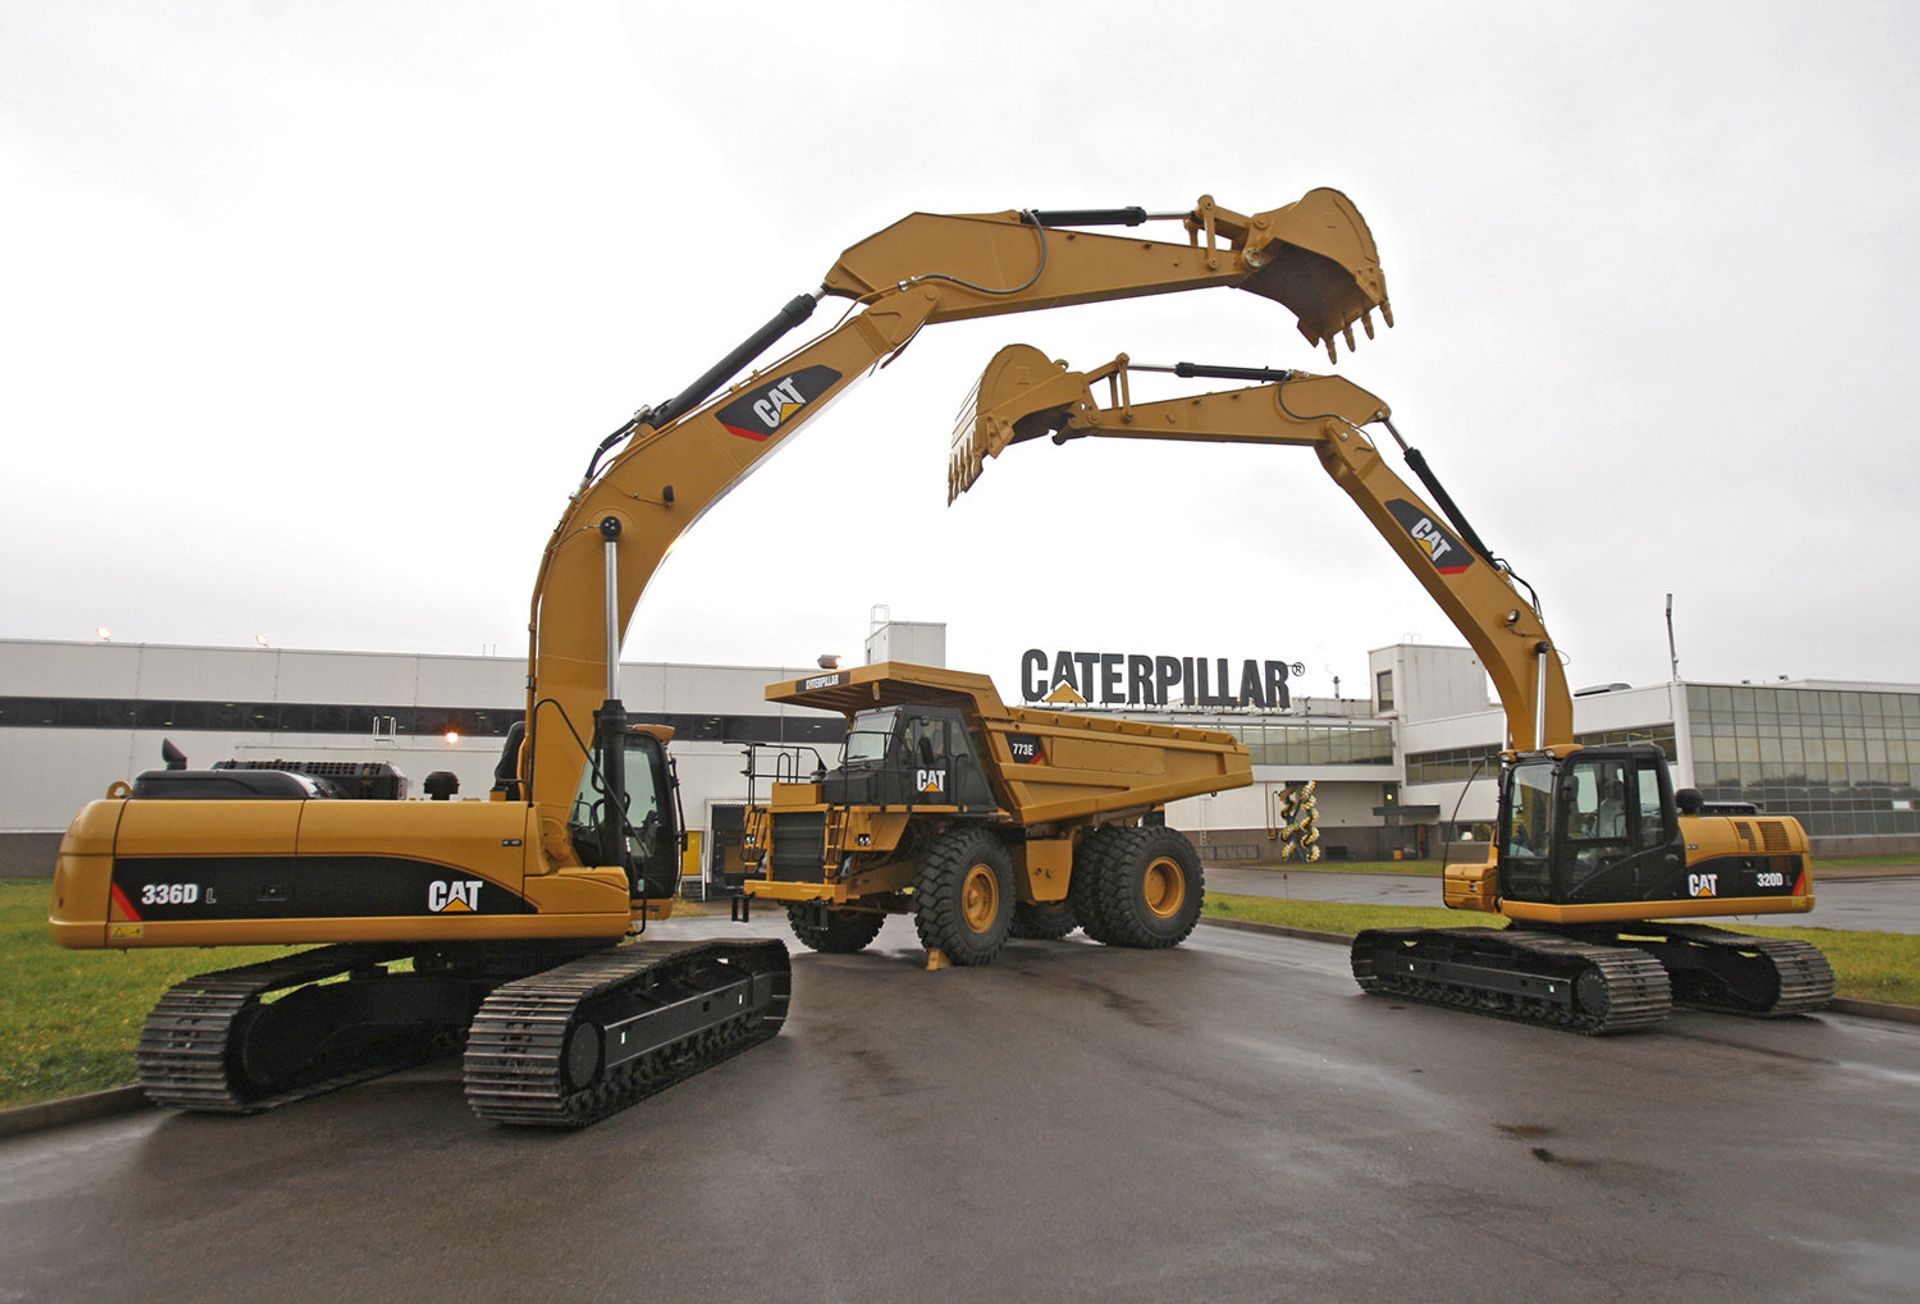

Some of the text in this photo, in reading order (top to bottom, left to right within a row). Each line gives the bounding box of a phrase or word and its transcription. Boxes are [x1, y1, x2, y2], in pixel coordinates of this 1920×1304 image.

[753, 377, 807, 428] CAT
[1410, 517, 1452, 562] CAT
[1012, 743, 1034, 756] 773E
[916, 769, 946, 792] CAT
[1688, 873, 1718, 897] CAT
[1757, 872, 1783, 887] 320D
[141, 883, 217, 905] 336D L
[428, 880, 484, 912] CAT
